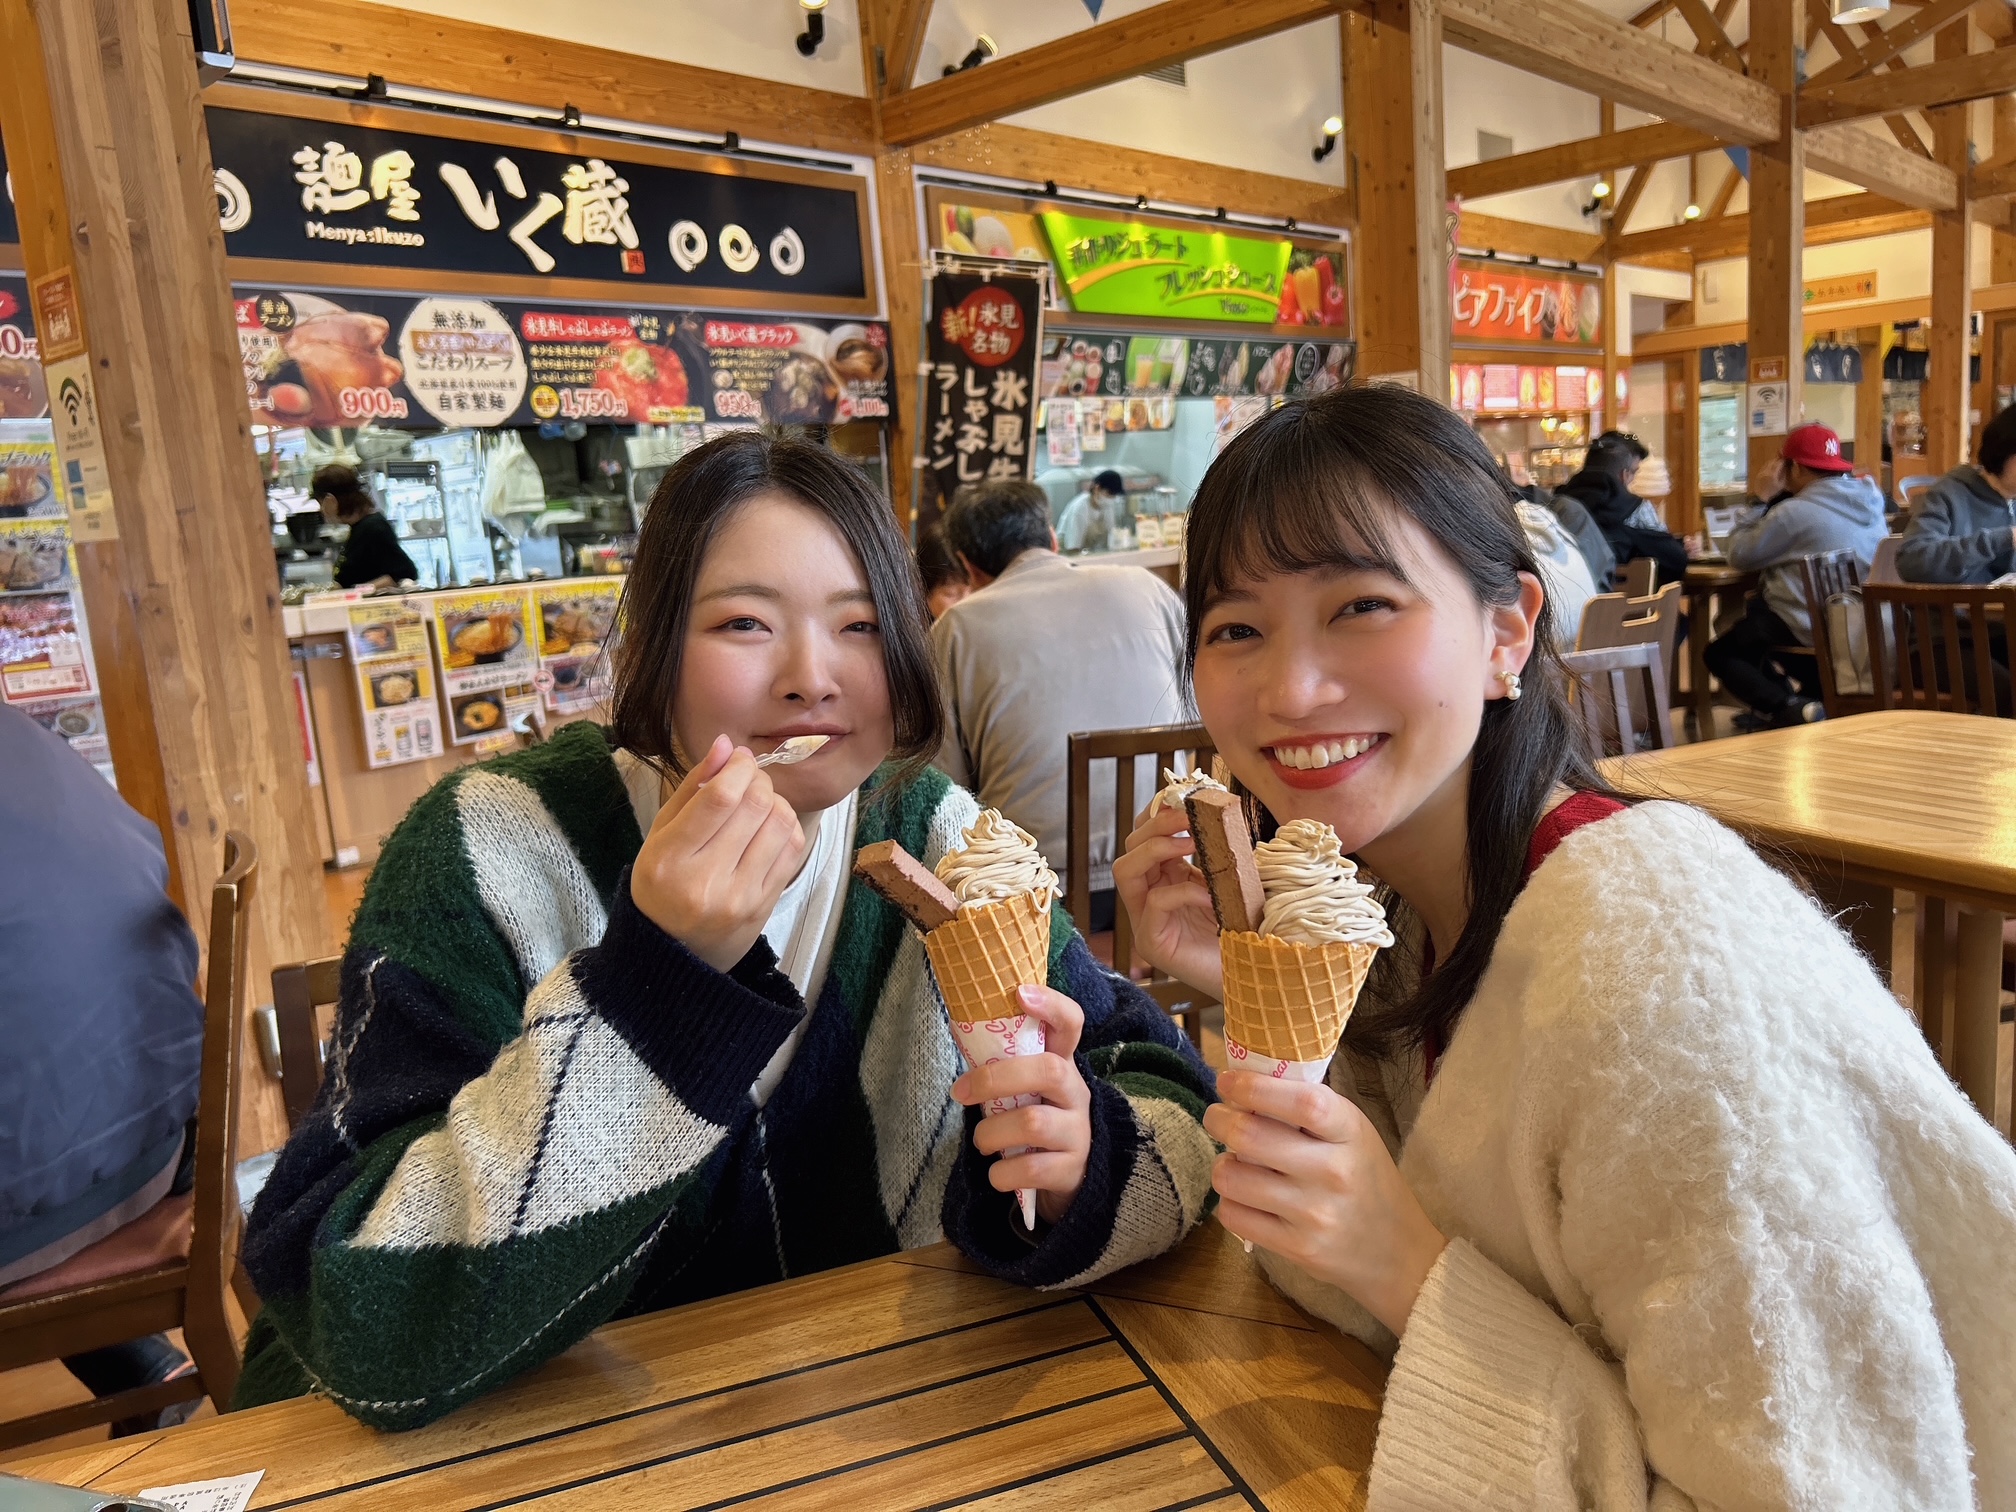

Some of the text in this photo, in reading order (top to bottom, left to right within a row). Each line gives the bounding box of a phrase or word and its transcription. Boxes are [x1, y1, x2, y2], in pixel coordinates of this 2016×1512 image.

[438, 156, 640, 273] いく蔵
[262, 300, 289, 314] 醤油
[433, 309, 486, 328] 無添加
[979, 302, 1019, 329] 氷見
[260, 315, 294, 328] ラーメン
[942, 304, 978, 344] 新!
[971, 331, 1011, 356] 名物
[416, 354, 514, 371] こだわりスープ
[342, 388, 407, 417] 900円
[439, 391, 506, 411] 自家製麺
[560, 390, 628, 418] 1,750円
[932, 362, 959, 471] ラーメン
[955, 366, 989, 489] しゃぶし
